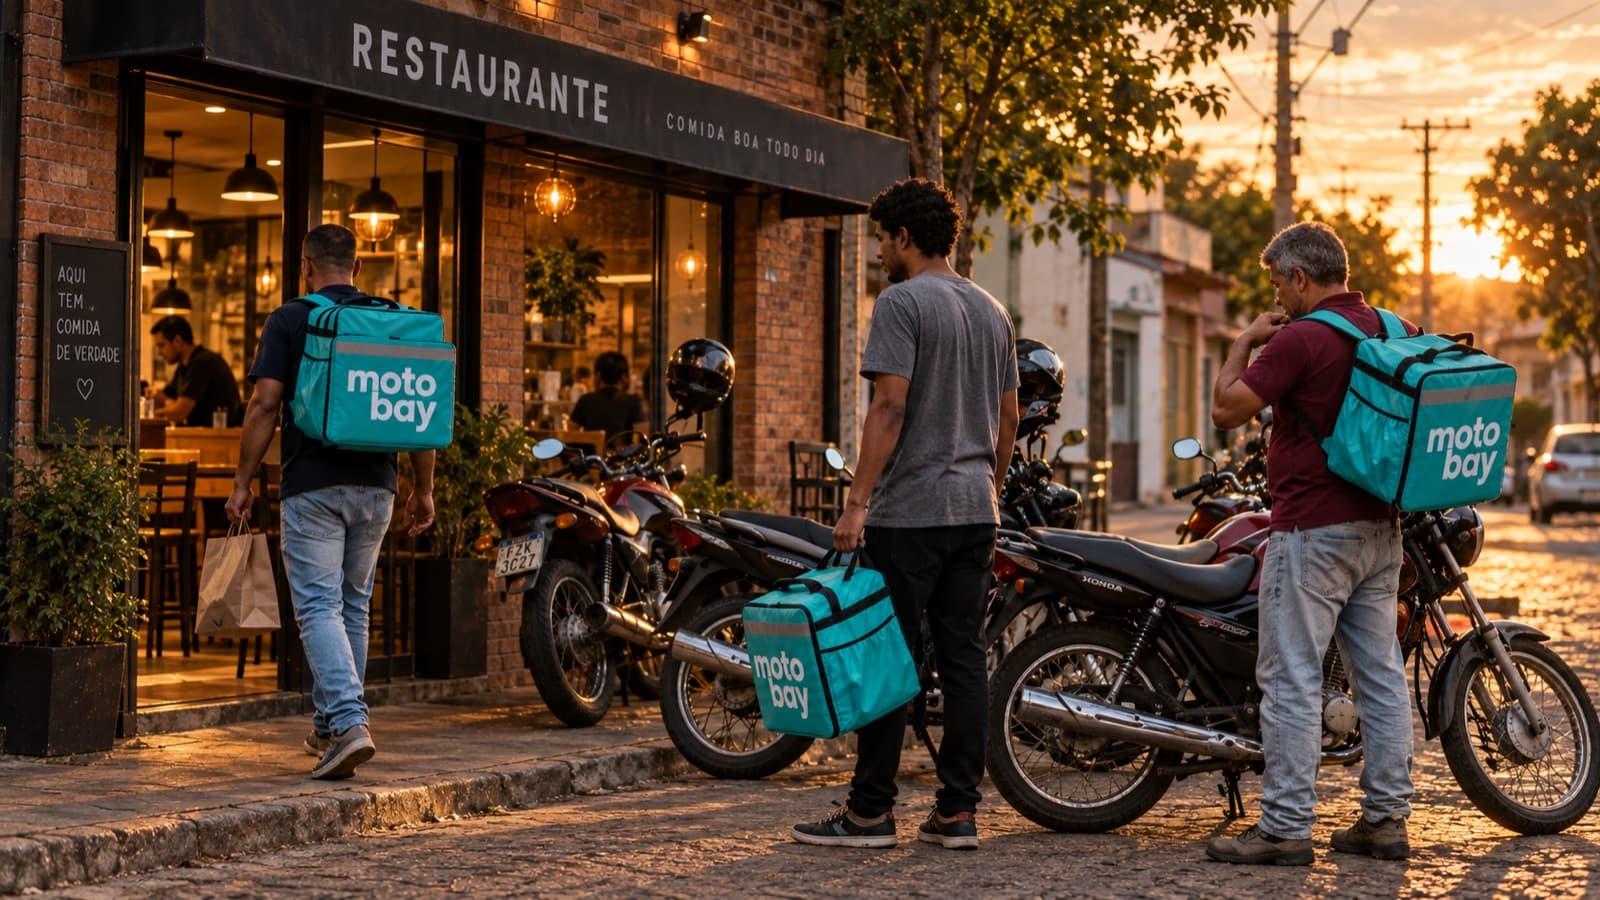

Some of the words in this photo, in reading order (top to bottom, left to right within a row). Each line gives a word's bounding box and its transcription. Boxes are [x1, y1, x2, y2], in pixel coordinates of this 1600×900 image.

[352, 23, 609, 125] RESTAURANTE
[666, 112, 725, 142] COMIDA
[734, 129, 759, 150] BOA
[766, 138, 799, 160] TODO
[805, 147, 825, 166] DIA
[57, 265, 86, 284] AQUI
[58, 292, 83, 310] TEM
[56, 318, 101, 336] COMIDA
[56, 344, 70, 361] DE
[74, 345, 120, 363] VERDADE
[347, 367, 437, 397] moto
[370, 391, 437, 433] bay
[1426, 416, 1501, 453] moto
[1442, 448, 1498, 486] bay
[500, 553, 536, 574] 3C27
[506, 542, 532, 559] FZK
[1082, 575, 1123, 593] HONDA
[753, 650, 805, 682] moto
[768, 676, 809, 720] bay
